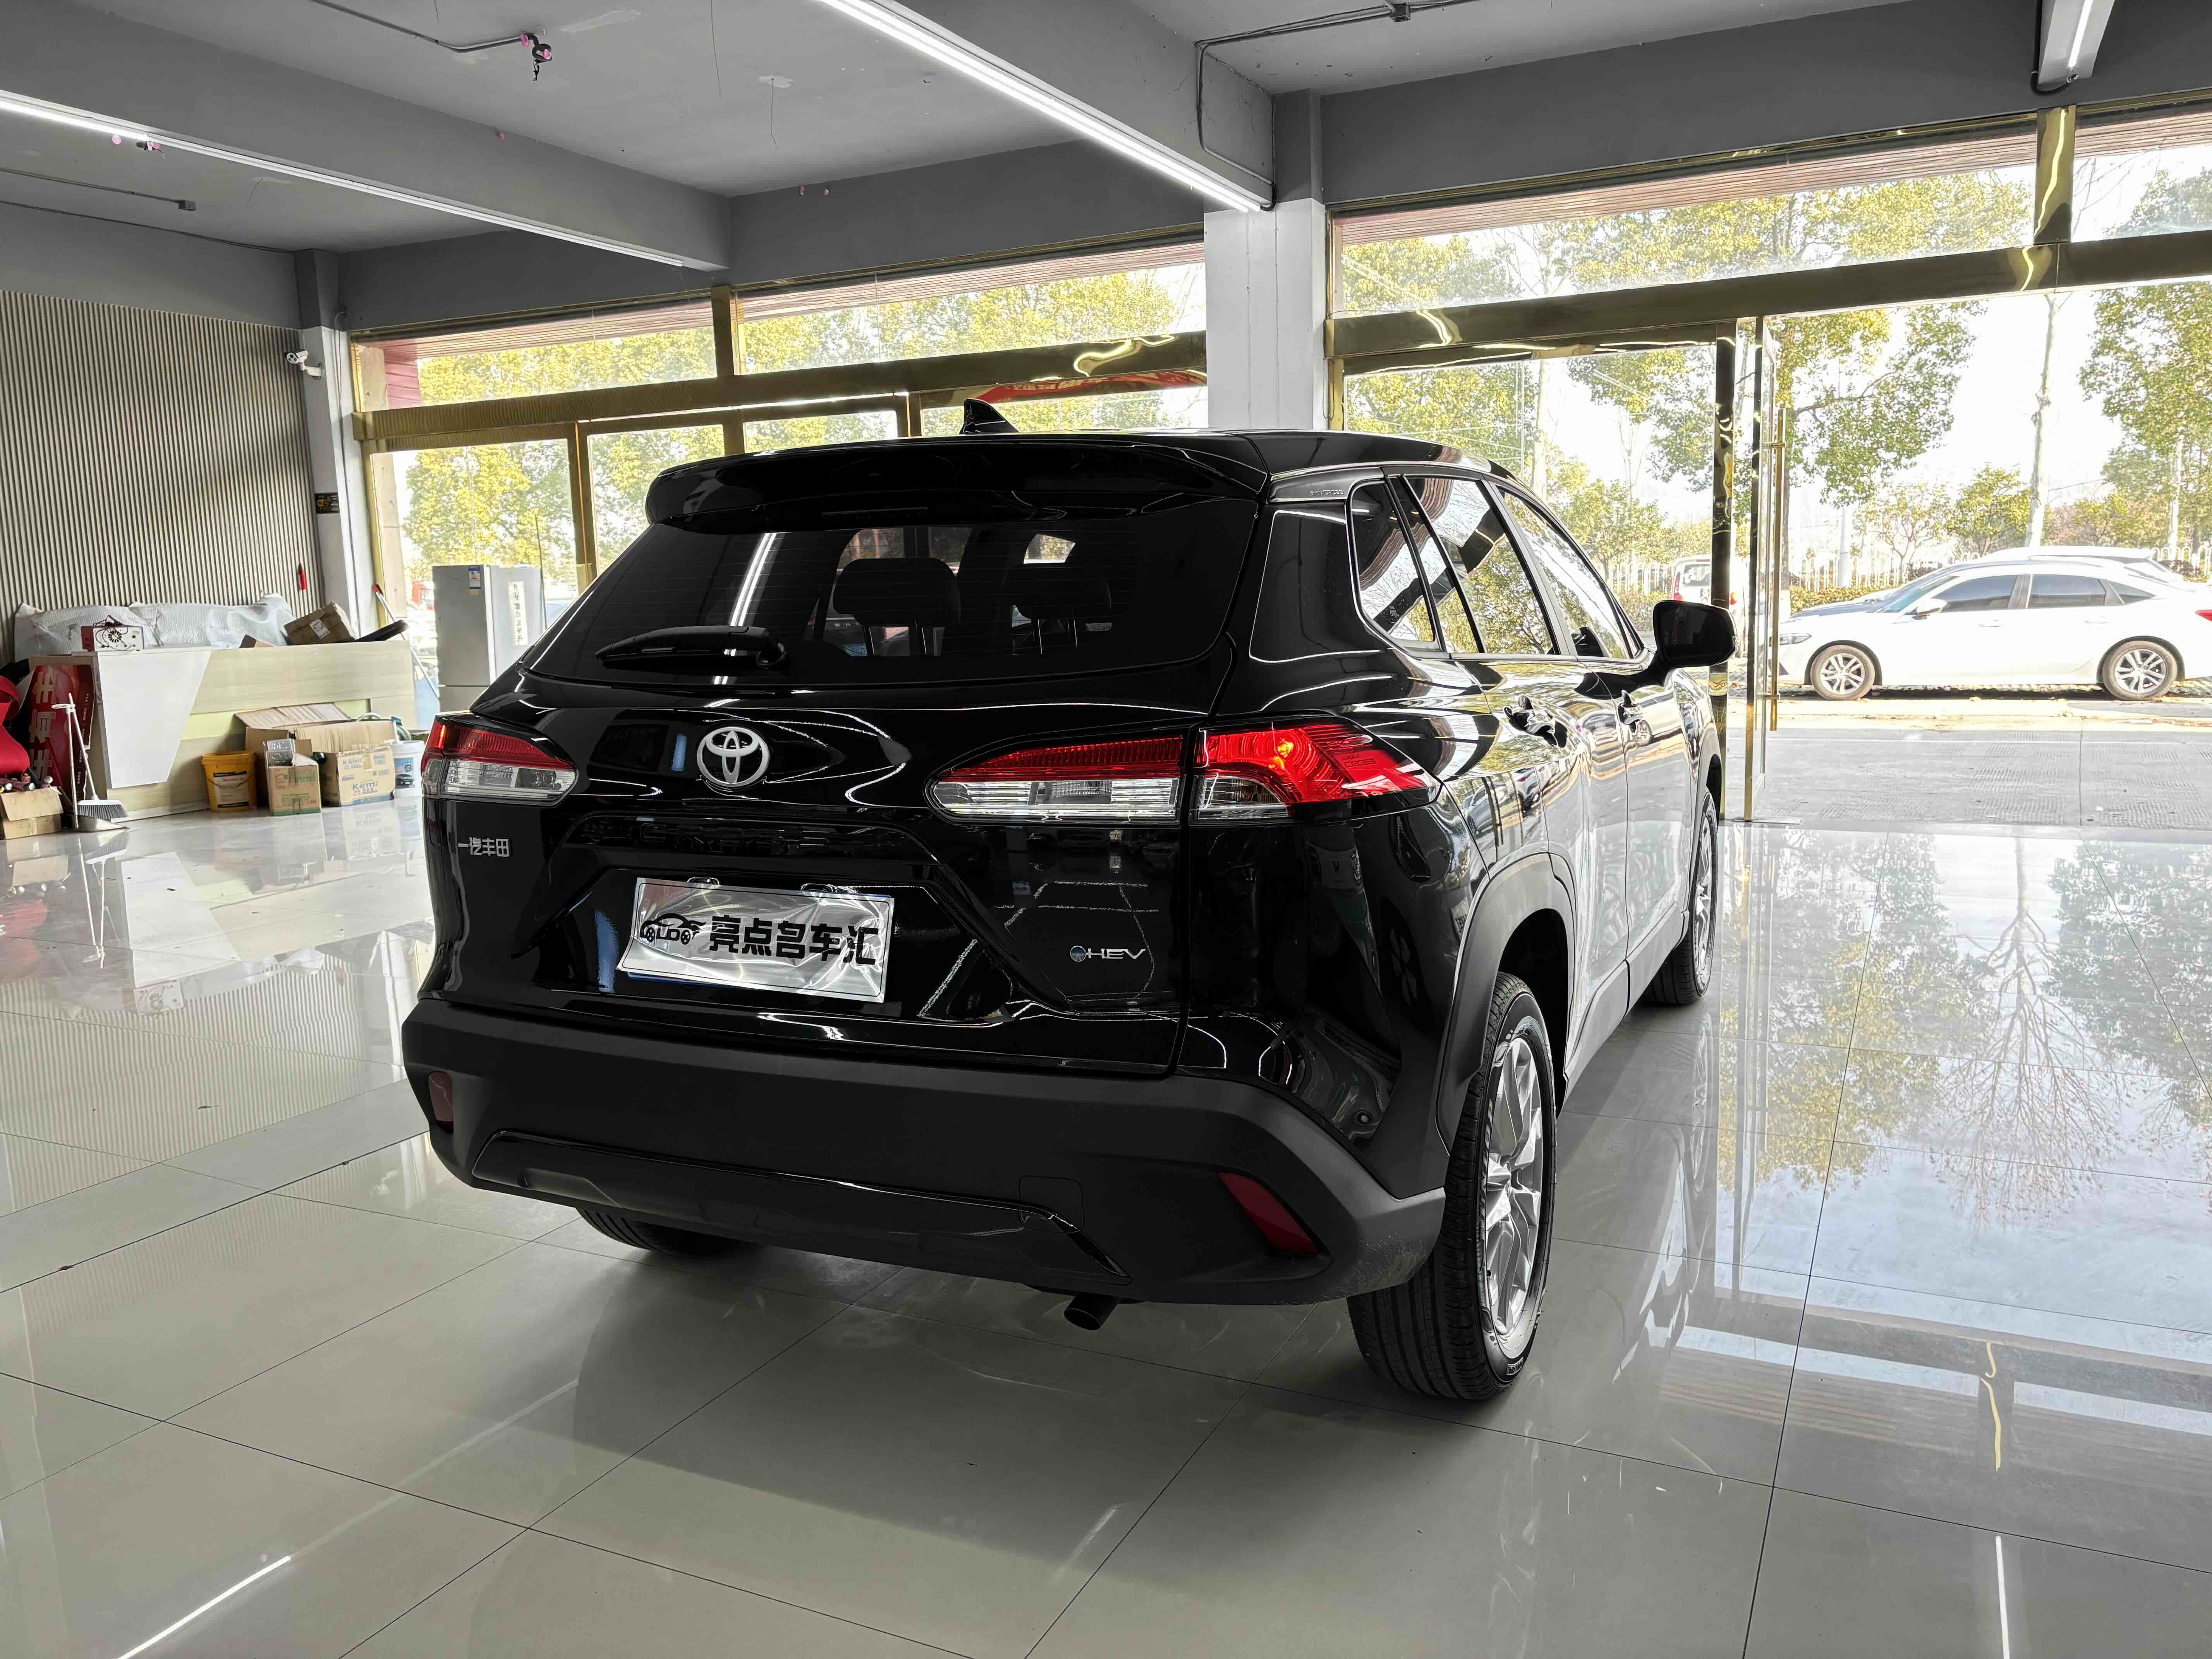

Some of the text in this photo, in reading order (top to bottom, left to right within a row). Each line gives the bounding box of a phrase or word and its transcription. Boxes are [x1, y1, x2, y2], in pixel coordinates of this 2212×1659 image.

[457, 837, 510, 857] 一汽丰田
[709, 915, 879, 965] 亮点名车汇
[1087, 948, 1146, 959] HEV
